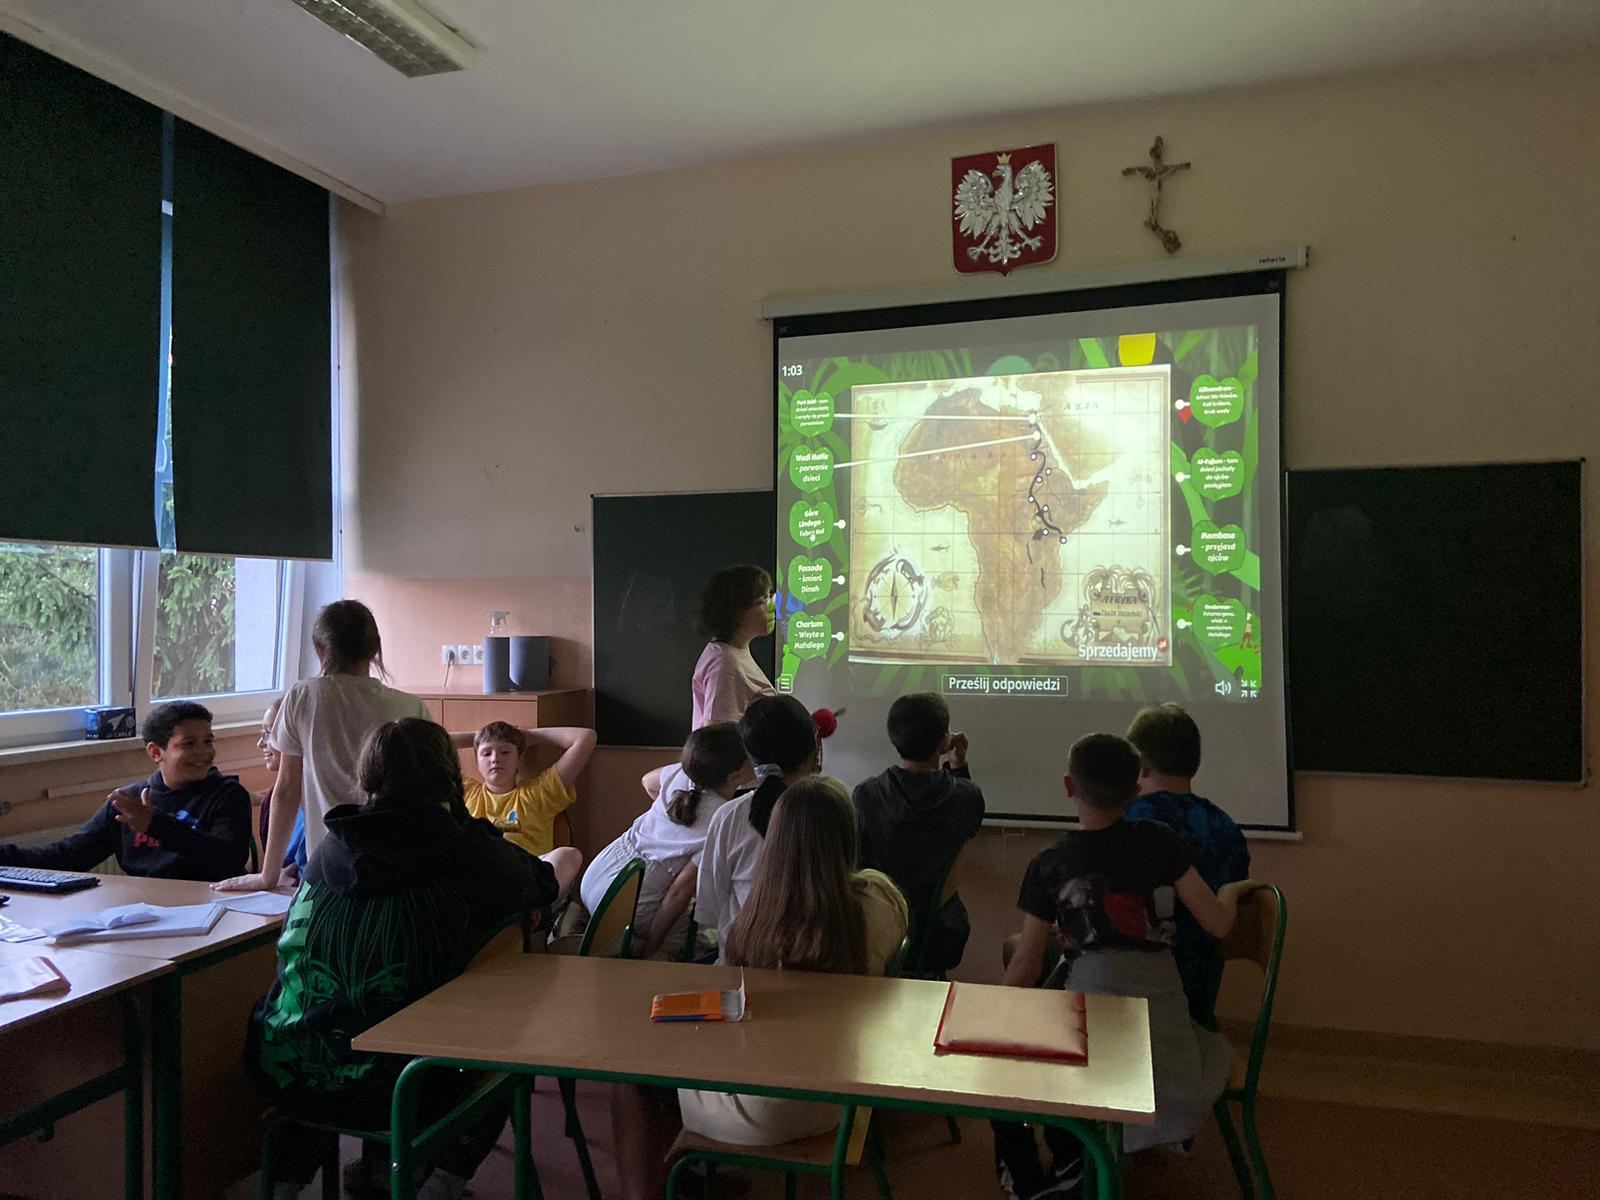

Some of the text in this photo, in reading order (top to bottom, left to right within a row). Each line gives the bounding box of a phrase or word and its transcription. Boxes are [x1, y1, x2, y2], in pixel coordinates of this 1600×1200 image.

[782, 364, 803, 377] 1:03
[1208, 553, 1229, 562] ojców
[794, 641, 824, 650] Mahdiego
[1078, 642, 1158, 660] Sprzedajemy
[948, 676, 1060, 694] Prześlij odpowiedzi
